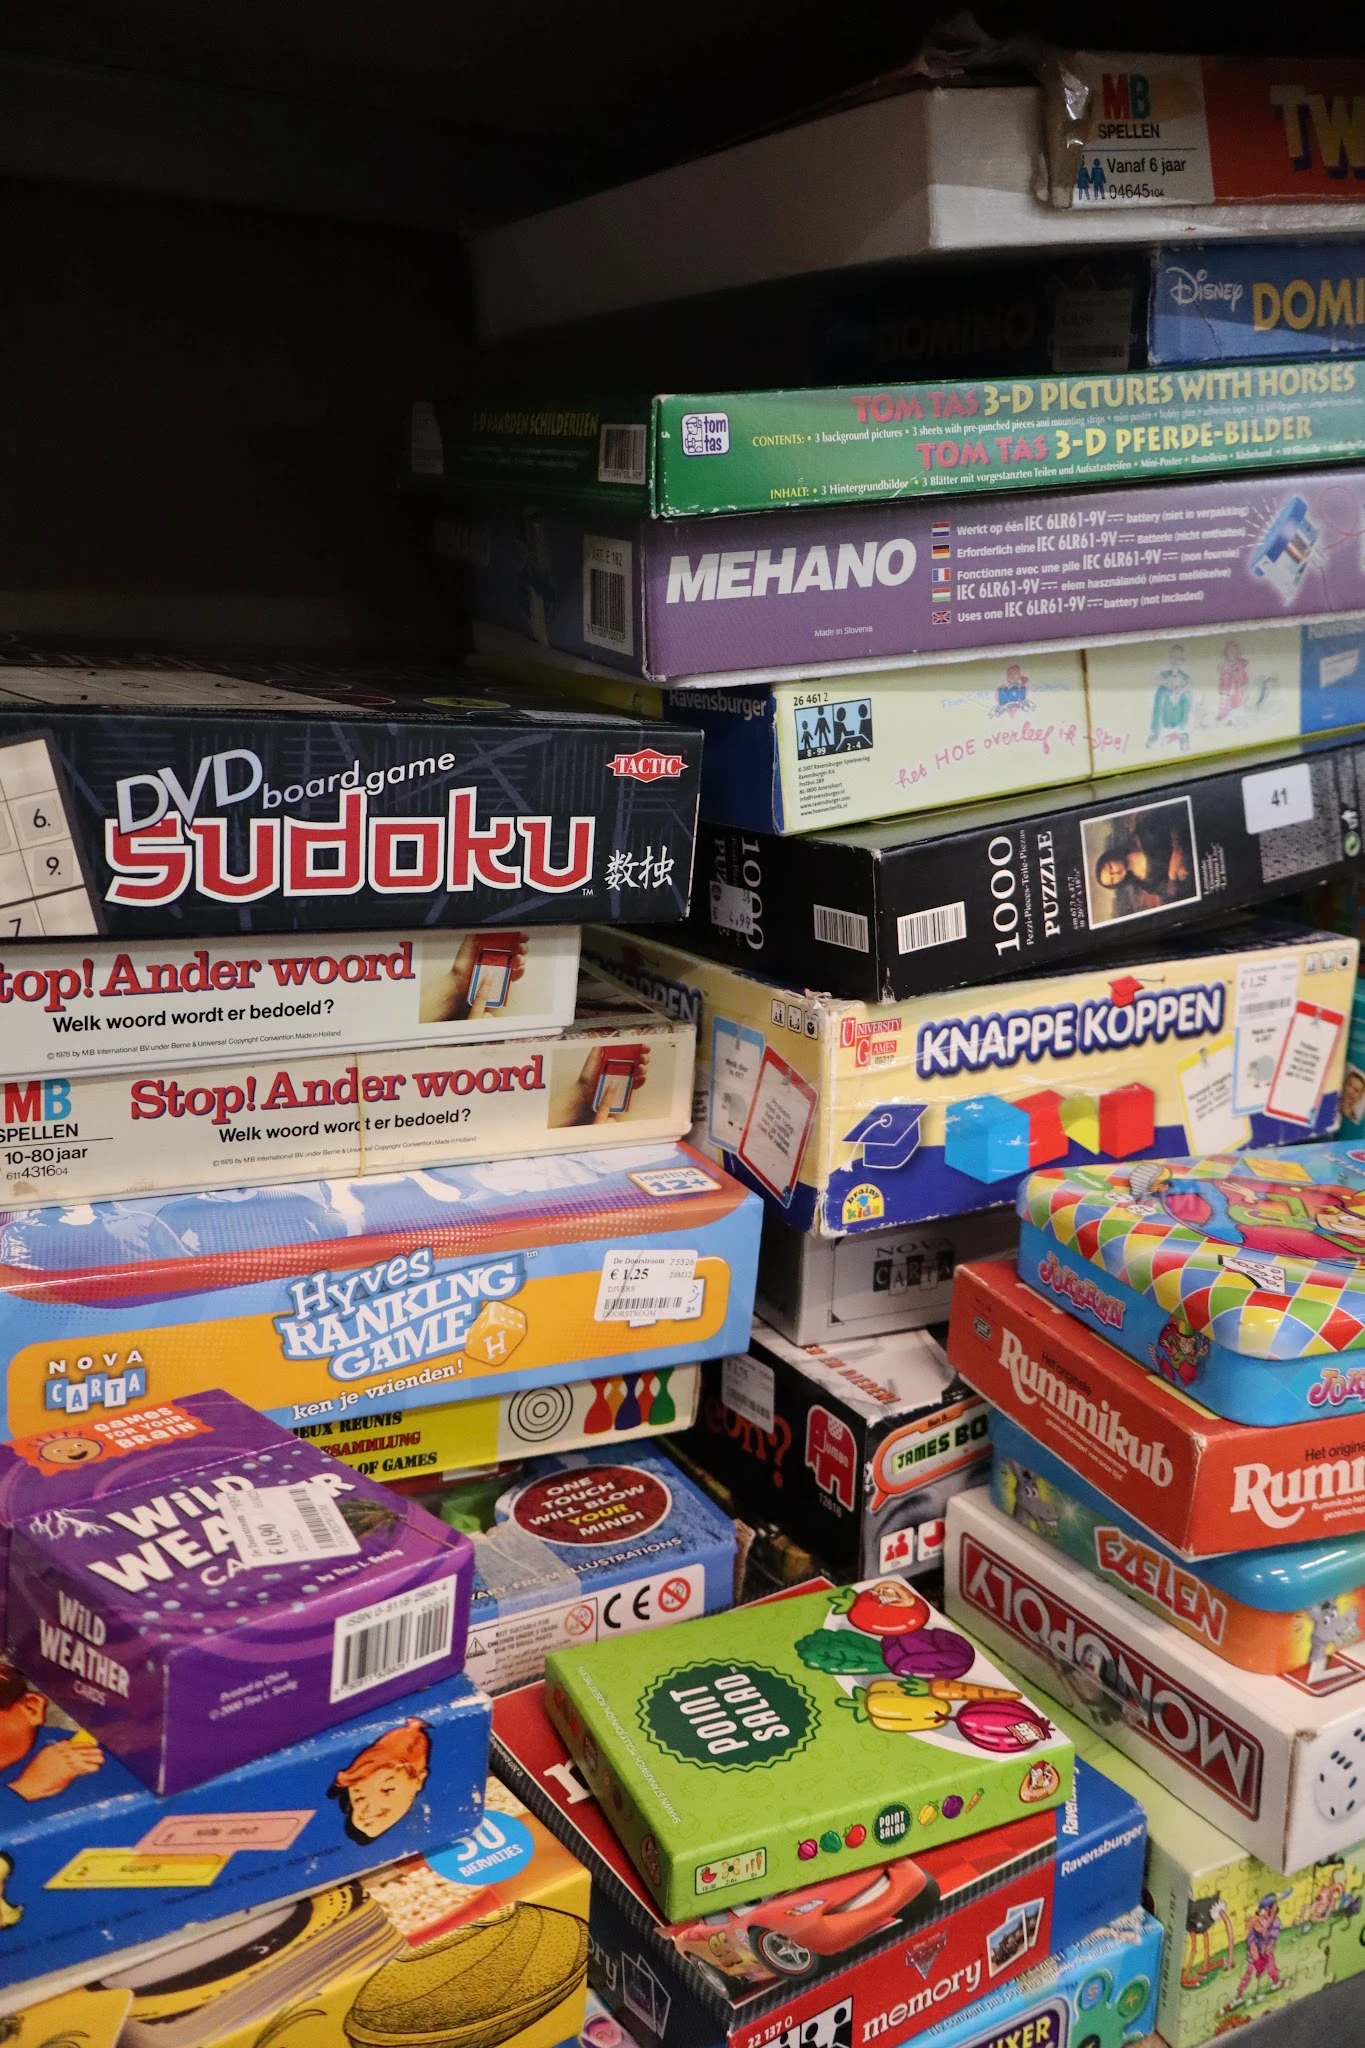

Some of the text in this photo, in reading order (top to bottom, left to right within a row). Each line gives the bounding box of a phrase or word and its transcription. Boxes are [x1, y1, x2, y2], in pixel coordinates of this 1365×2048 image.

[1102, 73, 1149, 119] MB
[1098, 124, 1160, 139] SPELLEN
[1107, 157, 1186, 175] Vanaf 6 jaar
[852, 394, 924, 424] TOM
[927, 389, 979, 419] TAS
[983, 384, 1034, 416] 3-D
[1041, 375, 1174, 411] PICTURES
[1177, 370, 1252, 402] WITH
[1258, 364, 1356, 397] HORSES
[703, 416, 728, 435] tom
[752, 420, 1010, 447] CONTENTS: background pictures sheets with pre-punched
[703, 435, 723, 455] tas
[916, 440, 990, 470] TOM
[995, 434, 1049, 464] TAS
[1055, 427, 1107, 459] 3-D
[1115, 415, 1313, 454] PFERDE-BILDER
[770, 473, 975, 500] INHALT: Blätter mit
[957, 509, 1160, 537] Werkt op één IEC 6LR61-9V battery
[957, 530, 1172, 559] Erforderlich eine IEC 6LR61-9V Batterie
[666, 538, 917, 604] MEHANO
[957, 548, 1161, 581] Fonctionne avec une pile IEC 6LR61-9V
[956, 577, 1085, 600] IEC 6LR61-9V elem
[957, 595, 1138, 623] Uses one IEC 6LR61-9V battery
[814, 624, 873, 637] Made Slovenia
[670, 689, 768, 721] Ravensburger
[793, 695, 804, 706] 26
[616, 756, 682, 776] TACTIC
[895, 723, 1054, 789] het HOE overleef
[116, 749, 456, 835] DVD board game
[1270, 787, 1289, 807] 41
[104, 786, 596, 907] sudoku
[604, 845, 676, 891] 数独
[988, 836, 1020, 956] 1000
[1037, 831, 1061, 938] PUZZLE
[99, 950, 262, 996] Ander
[268, 941, 416, 986] woord
[52, 1014, 101, 1033] Welk
[106, 1009, 166, 1029] woord
[171, 1005, 224, 1025] wordt
[227, 1006, 246, 1021] er
[840, 1017, 902, 1048] UNIVERSITY
[919, 985, 1224, 1075] KNAPPE KOPPEN
[228, 1036, 259, 1046] Copyright
[855, 1038, 897, 1068] GAMES
[4, 1078, 72, 1124] MB
[130, 1055, 546, 1125] Stop! Ander woord
[219, 1123, 262, 1143] Welk
[265, 1121, 320, 1139] woord
[373, 1114, 391, 1130] er
[4, 1147, 88, 1165] 10-80 jaar
[649, 1176, 708, 1194] 12+
[846, 1186, 880, 1205] brainy
[847, 1205, 881, 1221] kids
[292, 1249, 432, 1320] Hyves
[608, 1285, 636, 1293] DIVERS
[624, 1268, 649, 1281] 1,25
[279, 1260, 518, 1358] RANKING
[602, 1310, 656, 1318] DOORSTROOM
[332, 1303, 473, 1379] GAME
[49, 1349, 143, 1374] NOVA
[46, 1368, 146, 1413] CARTA
[293, 1358, 464, 1420] ken je vrienden!
[93, 1407, 174, 1434] GAMES
[999, 1326, 1174, 1488] Rummikub
[103, 1414, 186, 1441] FOR YOUR
[114, 1421, 198, 1450] BRAIN
[357, 1451, 438, 1475] OF GAMES
[896, 1436, 951, 1470] JAMES
[1305, 1447, 1327, 1462] Het
[540, 1481, 616, 1511] TOUCH
[546, 1476, 594, 1497] ONE
[106, 1475, 258, 1541] WILD
[528, 1484, 646, 1528] WILL BLOW
[568, 1502, 629, 1527] YOUR
[257, 1523, 282, 1547] 0,90
[578, 1510, 645, 1538] MIND!
[567, 1537, 684, 1575] ILLUSTRATIONS
[333, 1565, 358, 1578] Tina
[1096, 1527, 1227, 1645] EZELEN
[57, 1589, 107, 1646] WILD
[39, 1618, 130, 1700] WEATHER
[969, 1556, 1252, 1799] MONOPOLY
[669, 1685, 750, 1755] POINT
[713, 1672, 791, 1742] SALAD
[620, 1733, 638, 1756] MOLLY
[659, 1796, 682, 1825] SHAWN
[879, 1811, 905, 1829] POINT
[880, 1822, 906, 1841] SALAD
[458, 1843, 524, 1878] BIERVILTJES
[1061, 1824, 1144, 1877] Ravensburger
[862, 1959, 983, 2044] memory
[747, 2022, 782, 2048] 22 137
